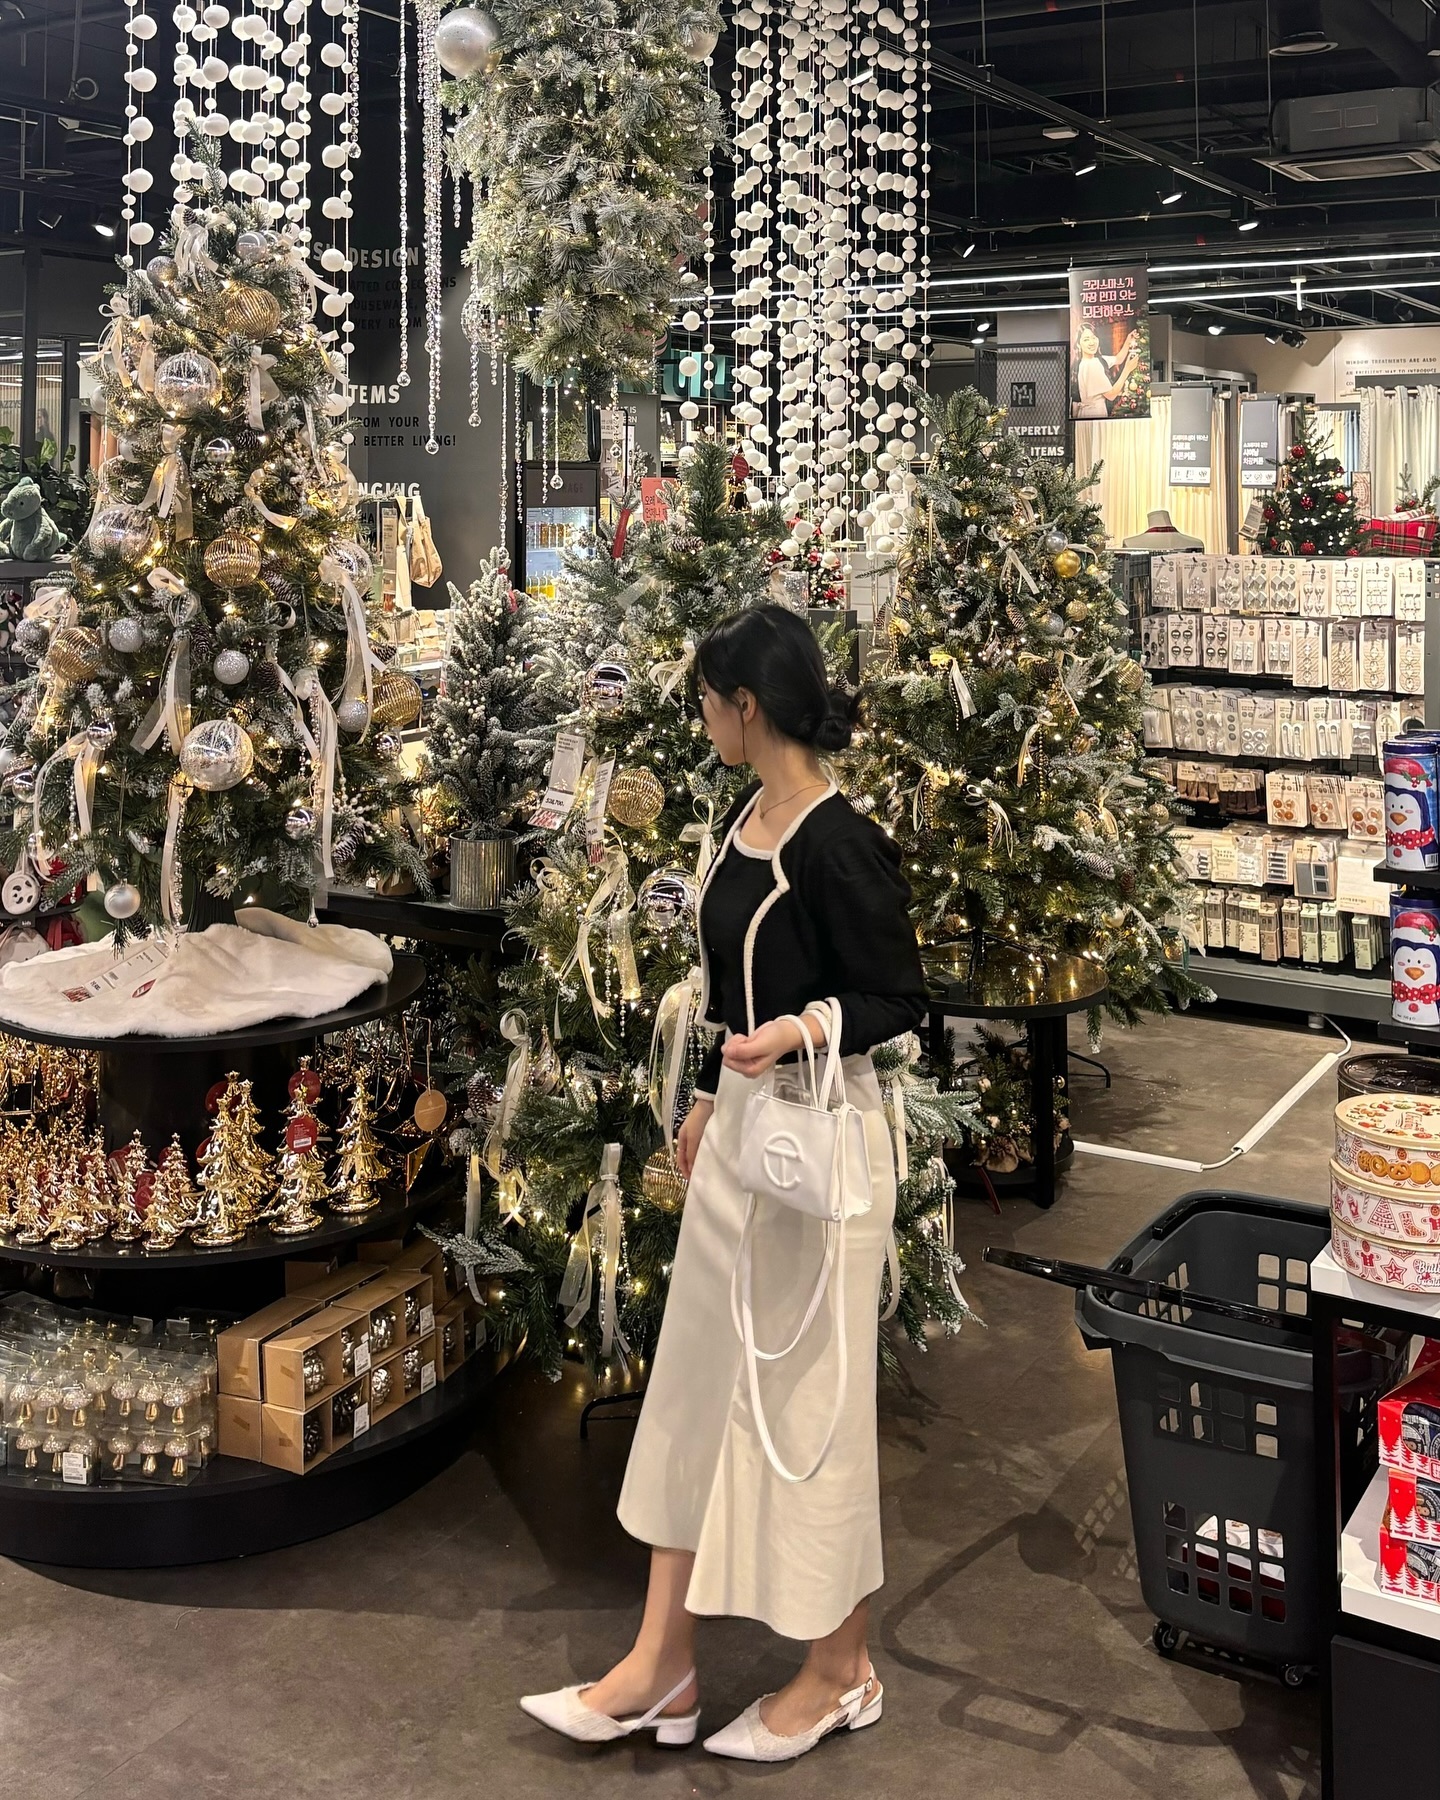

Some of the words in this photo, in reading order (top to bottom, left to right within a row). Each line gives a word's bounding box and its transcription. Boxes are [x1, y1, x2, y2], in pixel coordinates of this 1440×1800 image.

[348, 246, 417, 268] DESIGN
[1082, 277, 1134, 291] 크리스마스가
[1080, 291, 1097, 303] 가장
[1099, 290, 1117, 302] 먼저
[1118, 289, 1137, 300] 오는
[1082, 303, 1135, 319] 모던하우스
[388, 416, 420, 428] YOUR
[1007, 425, 1061, 436] EXPERTLY
[364, 435, 405, 447] BETTER
[412, 434, 457, 447] LIVNG!
[1030, 446, 1065, 457] ITEMS
